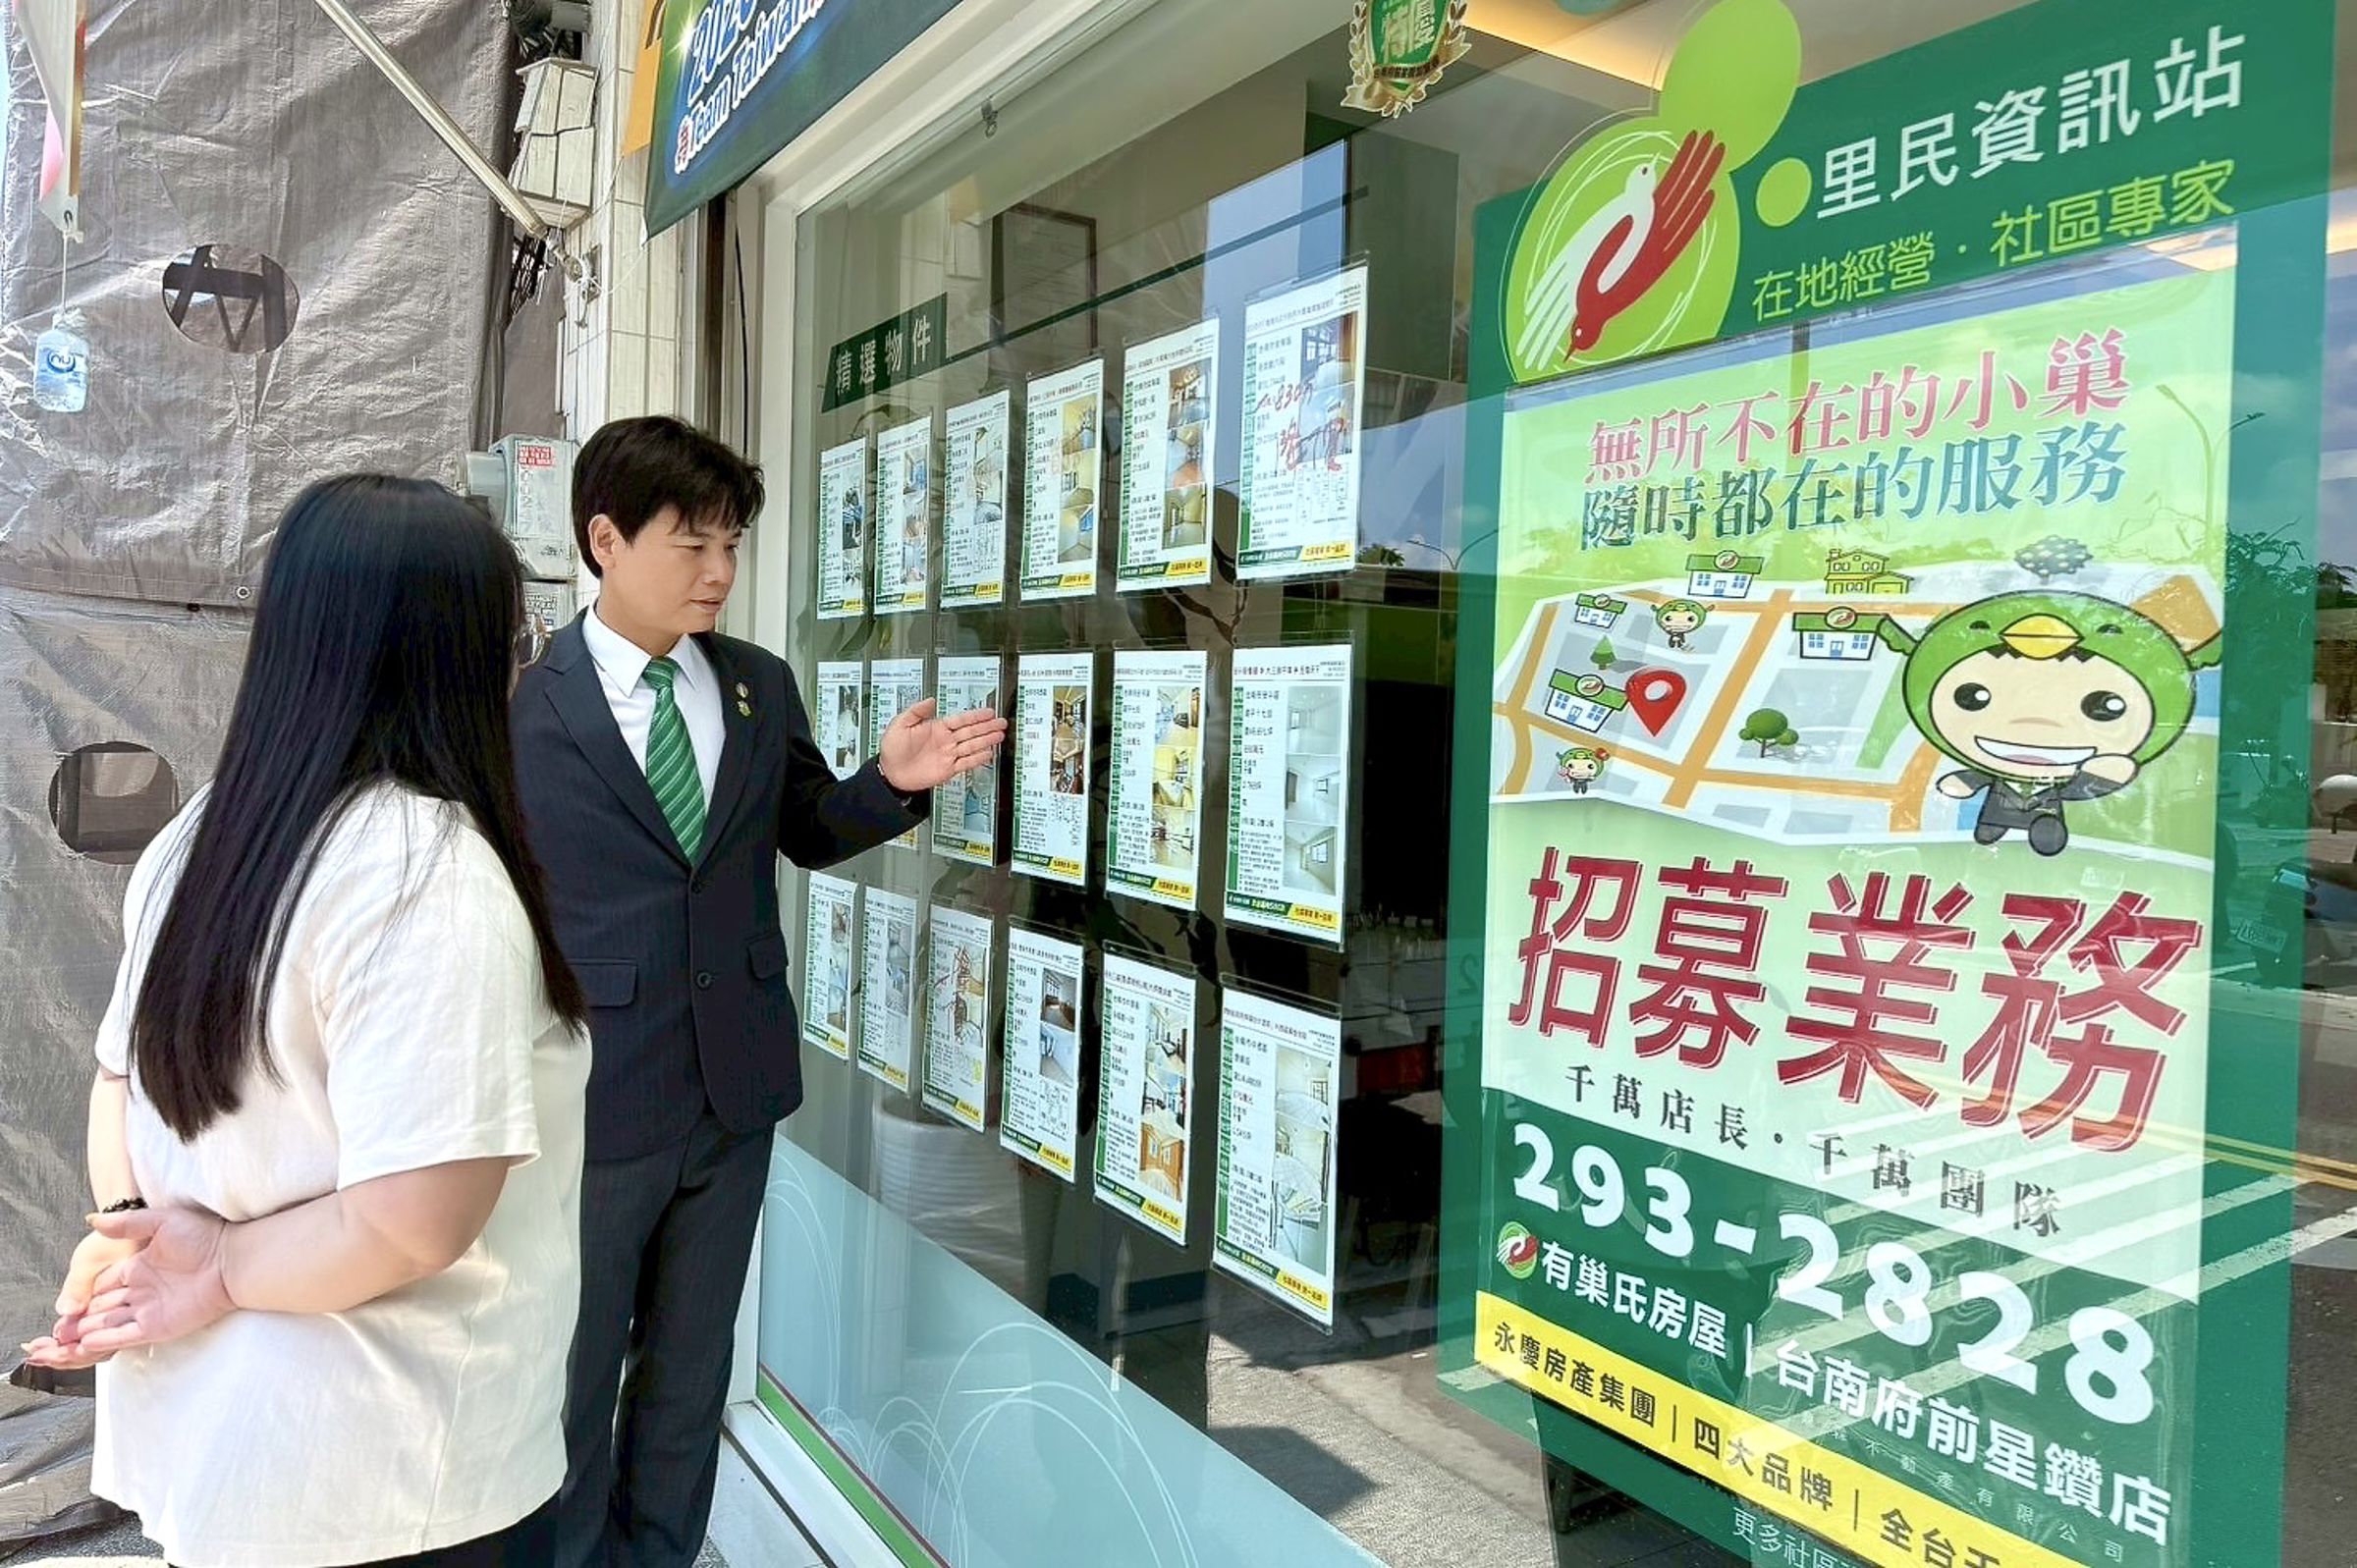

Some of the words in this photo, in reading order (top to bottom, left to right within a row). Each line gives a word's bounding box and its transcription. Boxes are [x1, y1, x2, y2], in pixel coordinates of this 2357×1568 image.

[1817, 25, 2245, 219] 里民資訊站
[1581, 422, 2127, 550] 隨時都在的服務
[1584, 328, 2129, 483] 無所不在的小巢
[1508, 846, 2204, 1153] 招募業務
[1513, 1122, 2155, 1426] 293-2828
[1494, 1322, 1656, 1428] 永慶房產集團
[1694, 1417, 1834, 1511] 四大品牌
[1541, 1240, 1727, 1359] 有巢氏房屋
[1776, 1338, 2171, 1545] 台南府前星鑽店
